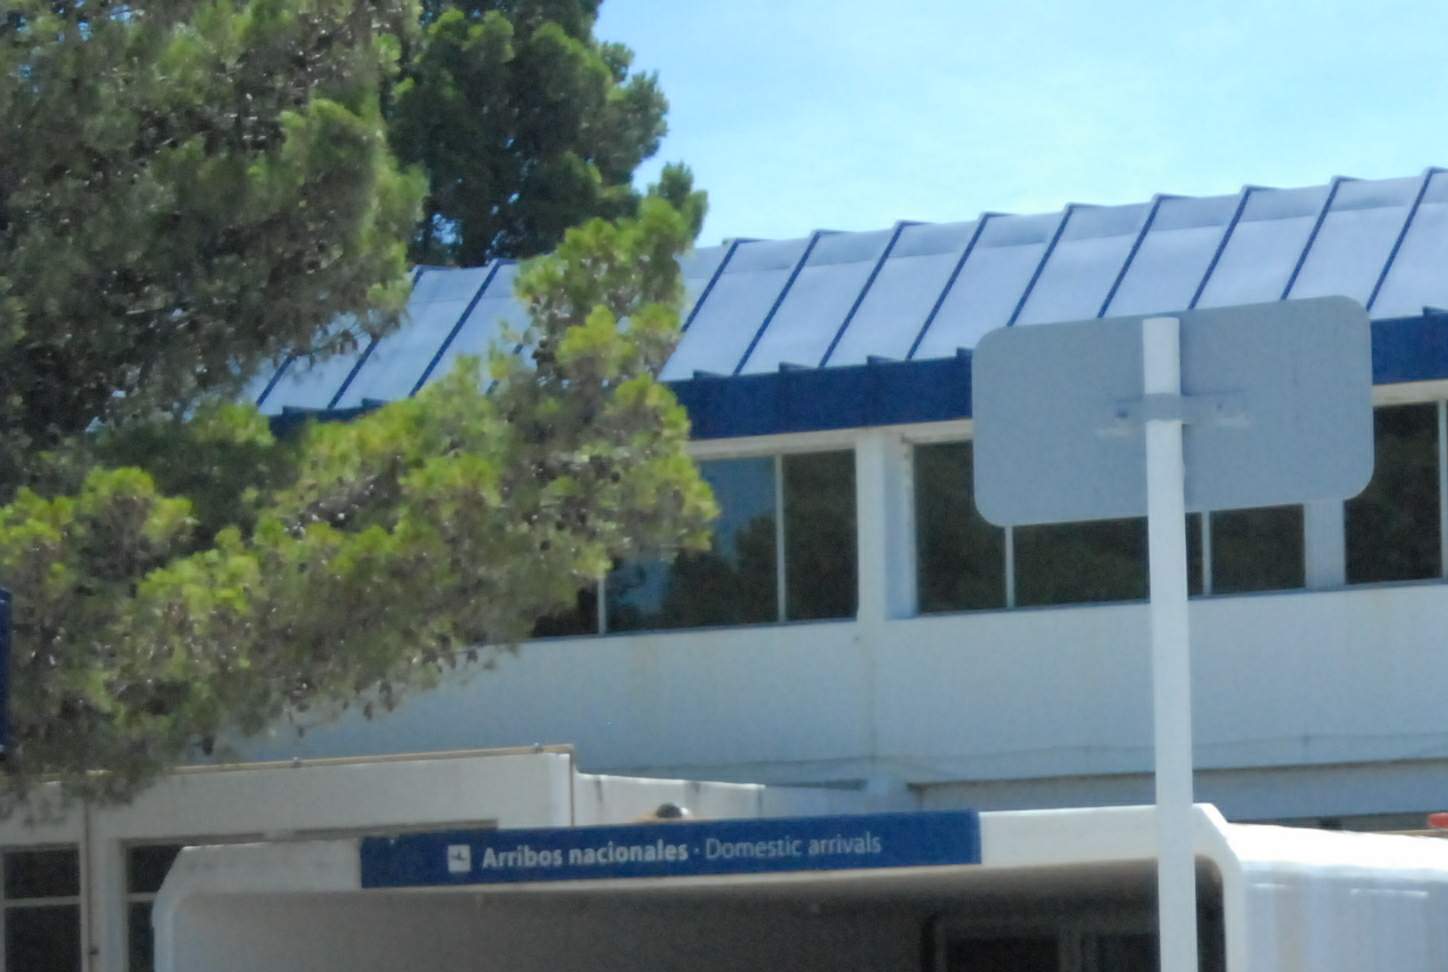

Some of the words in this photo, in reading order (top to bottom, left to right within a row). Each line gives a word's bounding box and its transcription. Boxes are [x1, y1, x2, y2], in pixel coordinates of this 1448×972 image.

[482, 845, 563, 868] Arribos
[568, 839, 689, 865] nacionales
[705, 835, 802, 860] Domestic
[808, 831, 882, 855] arrivals
